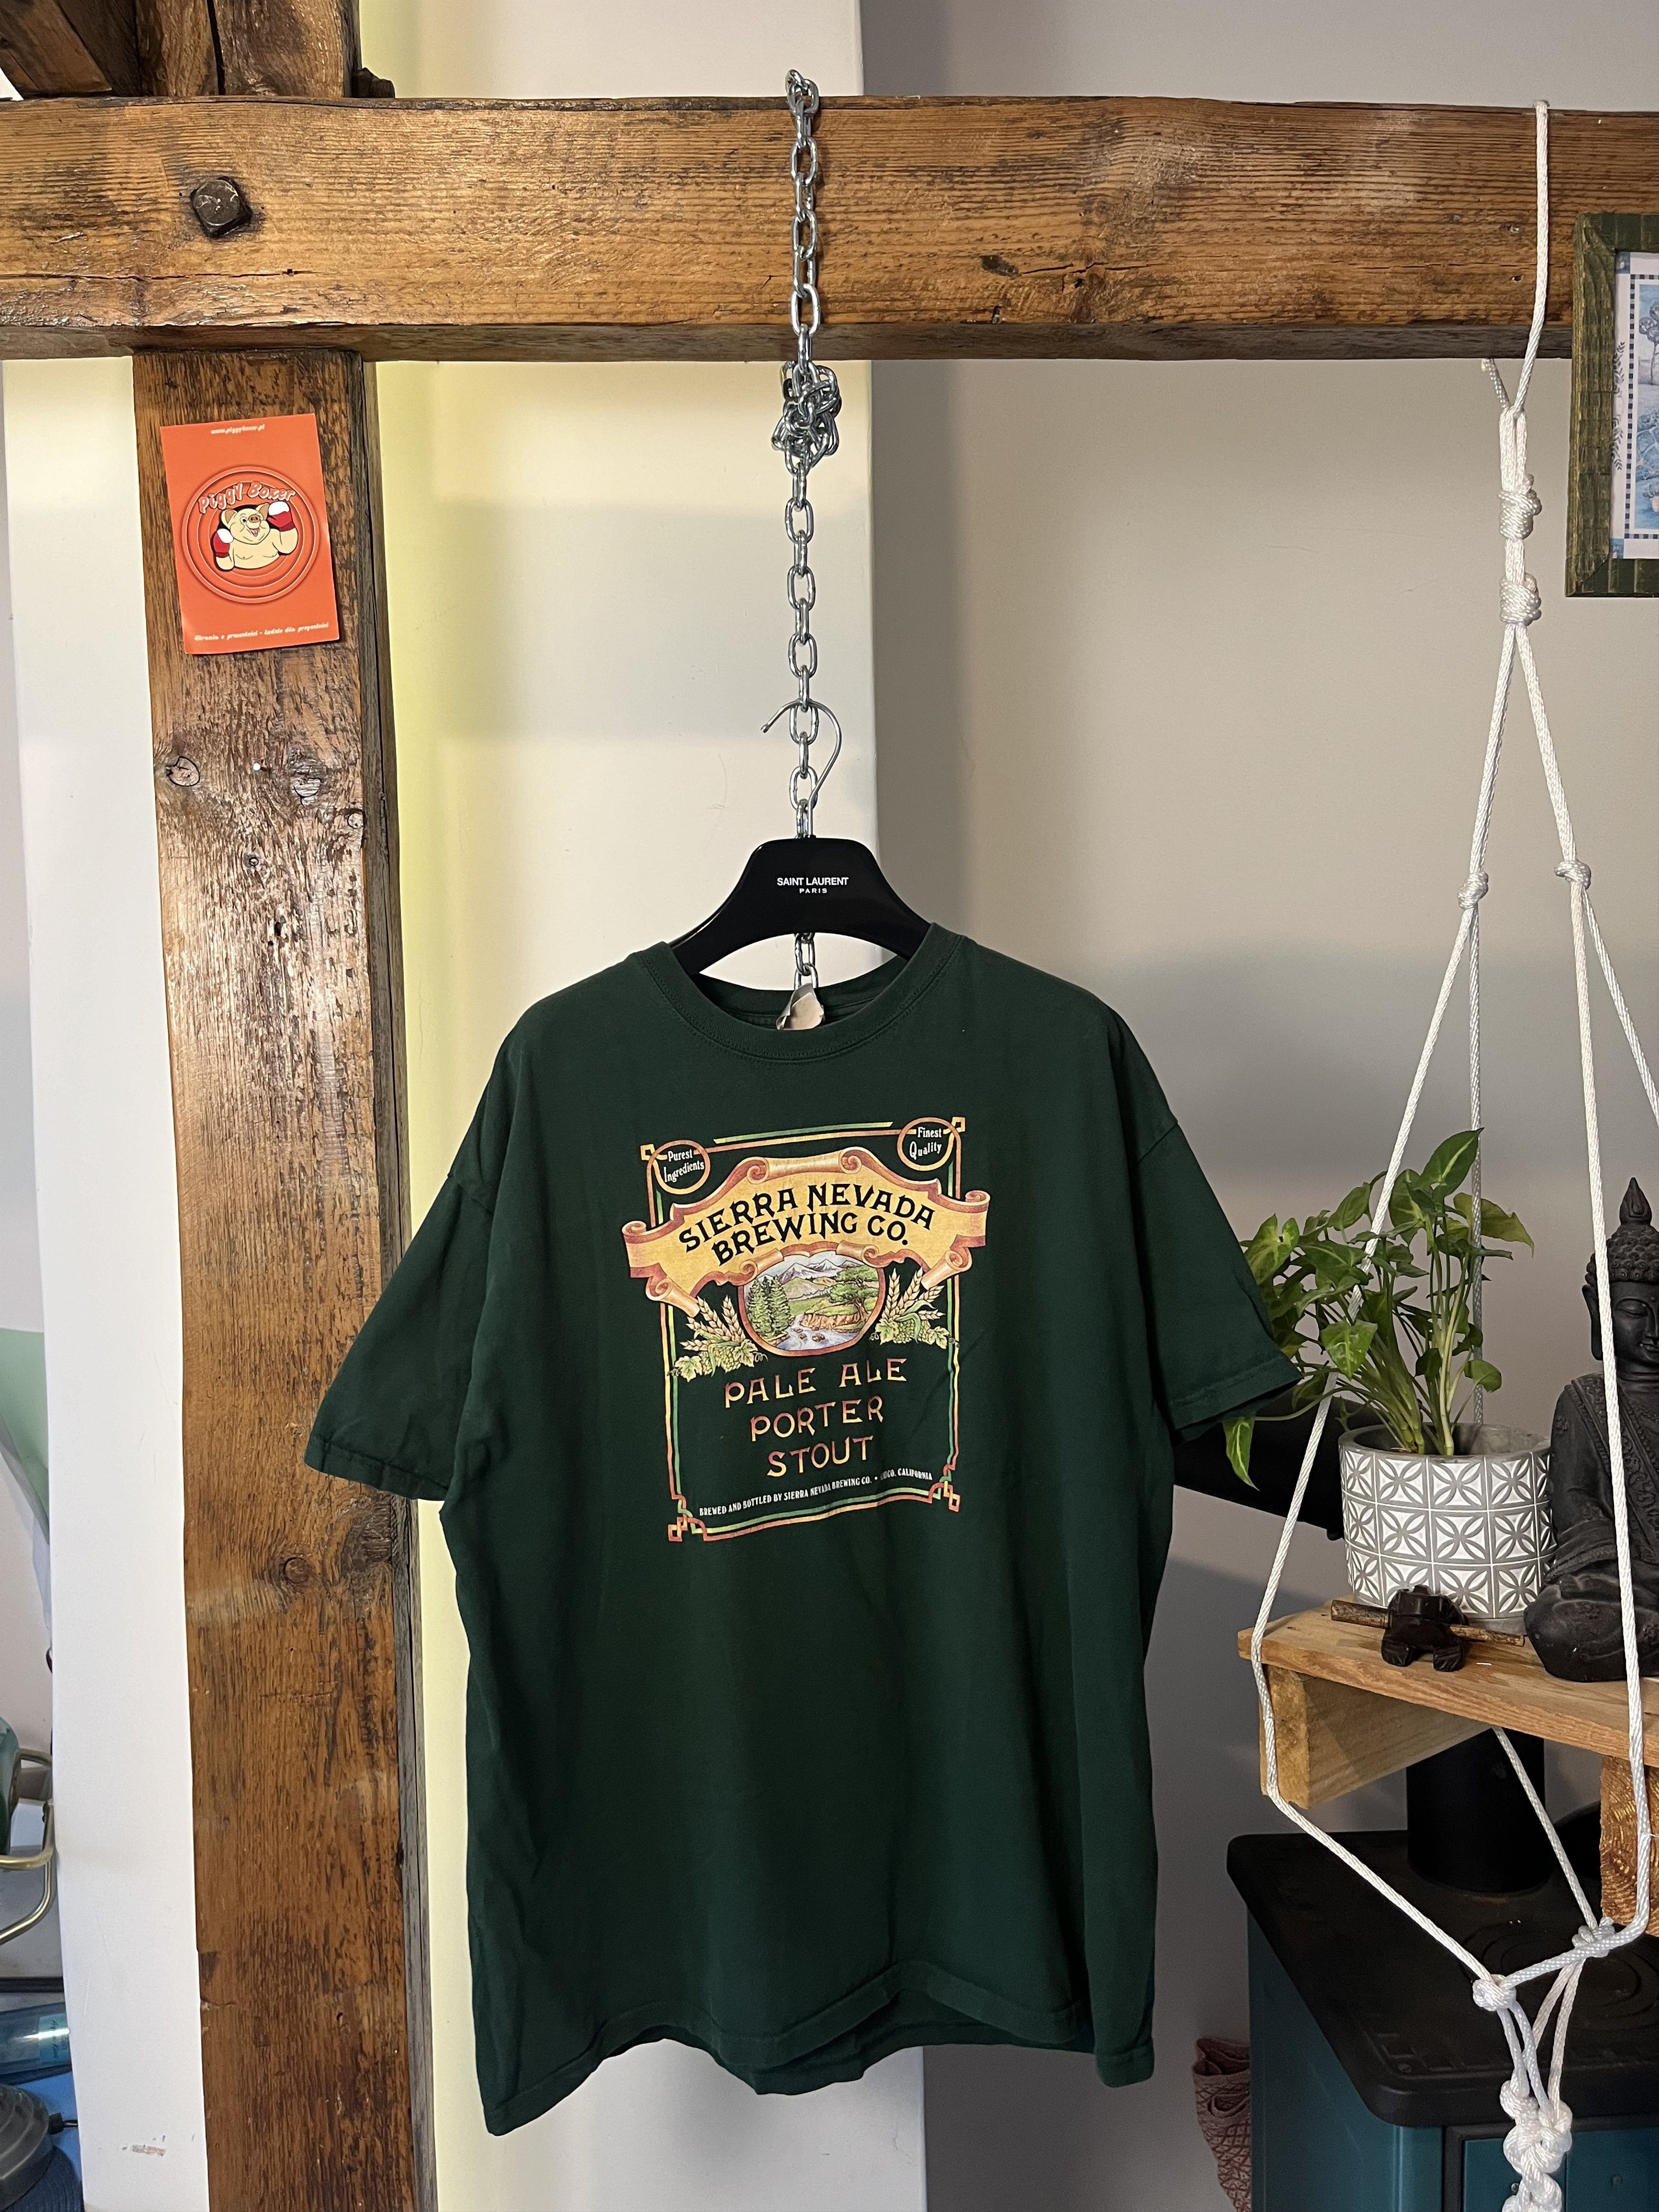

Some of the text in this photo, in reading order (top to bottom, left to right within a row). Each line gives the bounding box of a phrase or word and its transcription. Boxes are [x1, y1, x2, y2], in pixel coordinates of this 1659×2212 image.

[246, 481, 296, 501] Boxer
[777, 877, 849, 886] SAINT LAURENT
[918, 1127, 942, 1138] Finest
[667, 1149, 693, 1162] Purest
[909, 1141, 942, 1160] Quality
[664, 1160, 704, 1183] Ingredients
[679, 1183, 935, 1253] SIERRA NEVADA
[711, 1210, 908, 1266] BREWING CO.
[724, 1358, 907, 1409] PALE ALE
[749, 1395, 884, 1442] PORTER
[766, 1435, 874, 1477] STOUT
[699, 1506, 727, 1516] BREWED
[728, 1502, 742, 1513] AND
[743, 1495, 772, 1509] BOTTLED
[774, 1493, 782, 1502] BY
[784, 1489, 809, 1501] SIERRA
[810, 1483, 831, 1497] NEVADA
[832, 1478, 860, 1490] BREWING
[861, 1476, 872, 1484] CO.
[897, 1468, 933, 1480] CALIFORNIA
